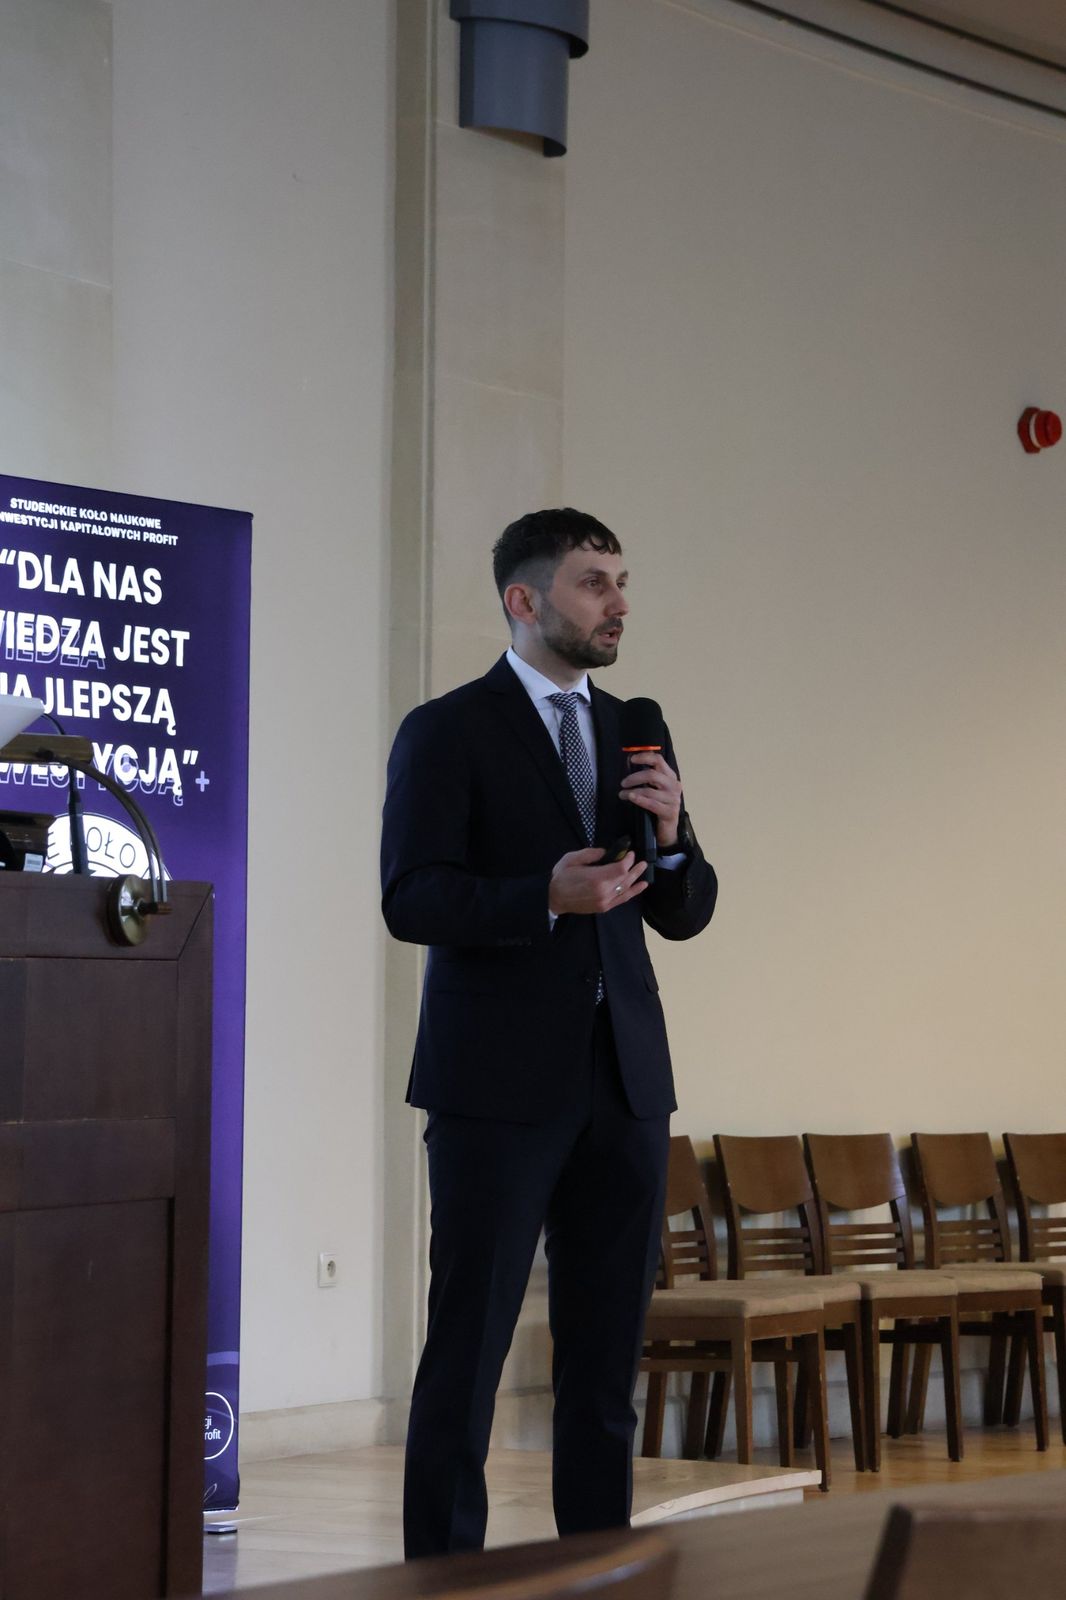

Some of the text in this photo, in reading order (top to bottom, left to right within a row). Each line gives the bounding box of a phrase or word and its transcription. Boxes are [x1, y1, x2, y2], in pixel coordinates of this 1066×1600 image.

[10, 497, 161, 529] STUDENCKIE KOŁO NAUKOWE
[60, 520, 140, 541] KAPITAŁOWYCH
[143, 531, 178, 546] PROFIT
[93, 561, 163, 605] NAS
[0, 610, 190, 667] IEDZA JEST
[70, 826, 136, 868] OŁO
